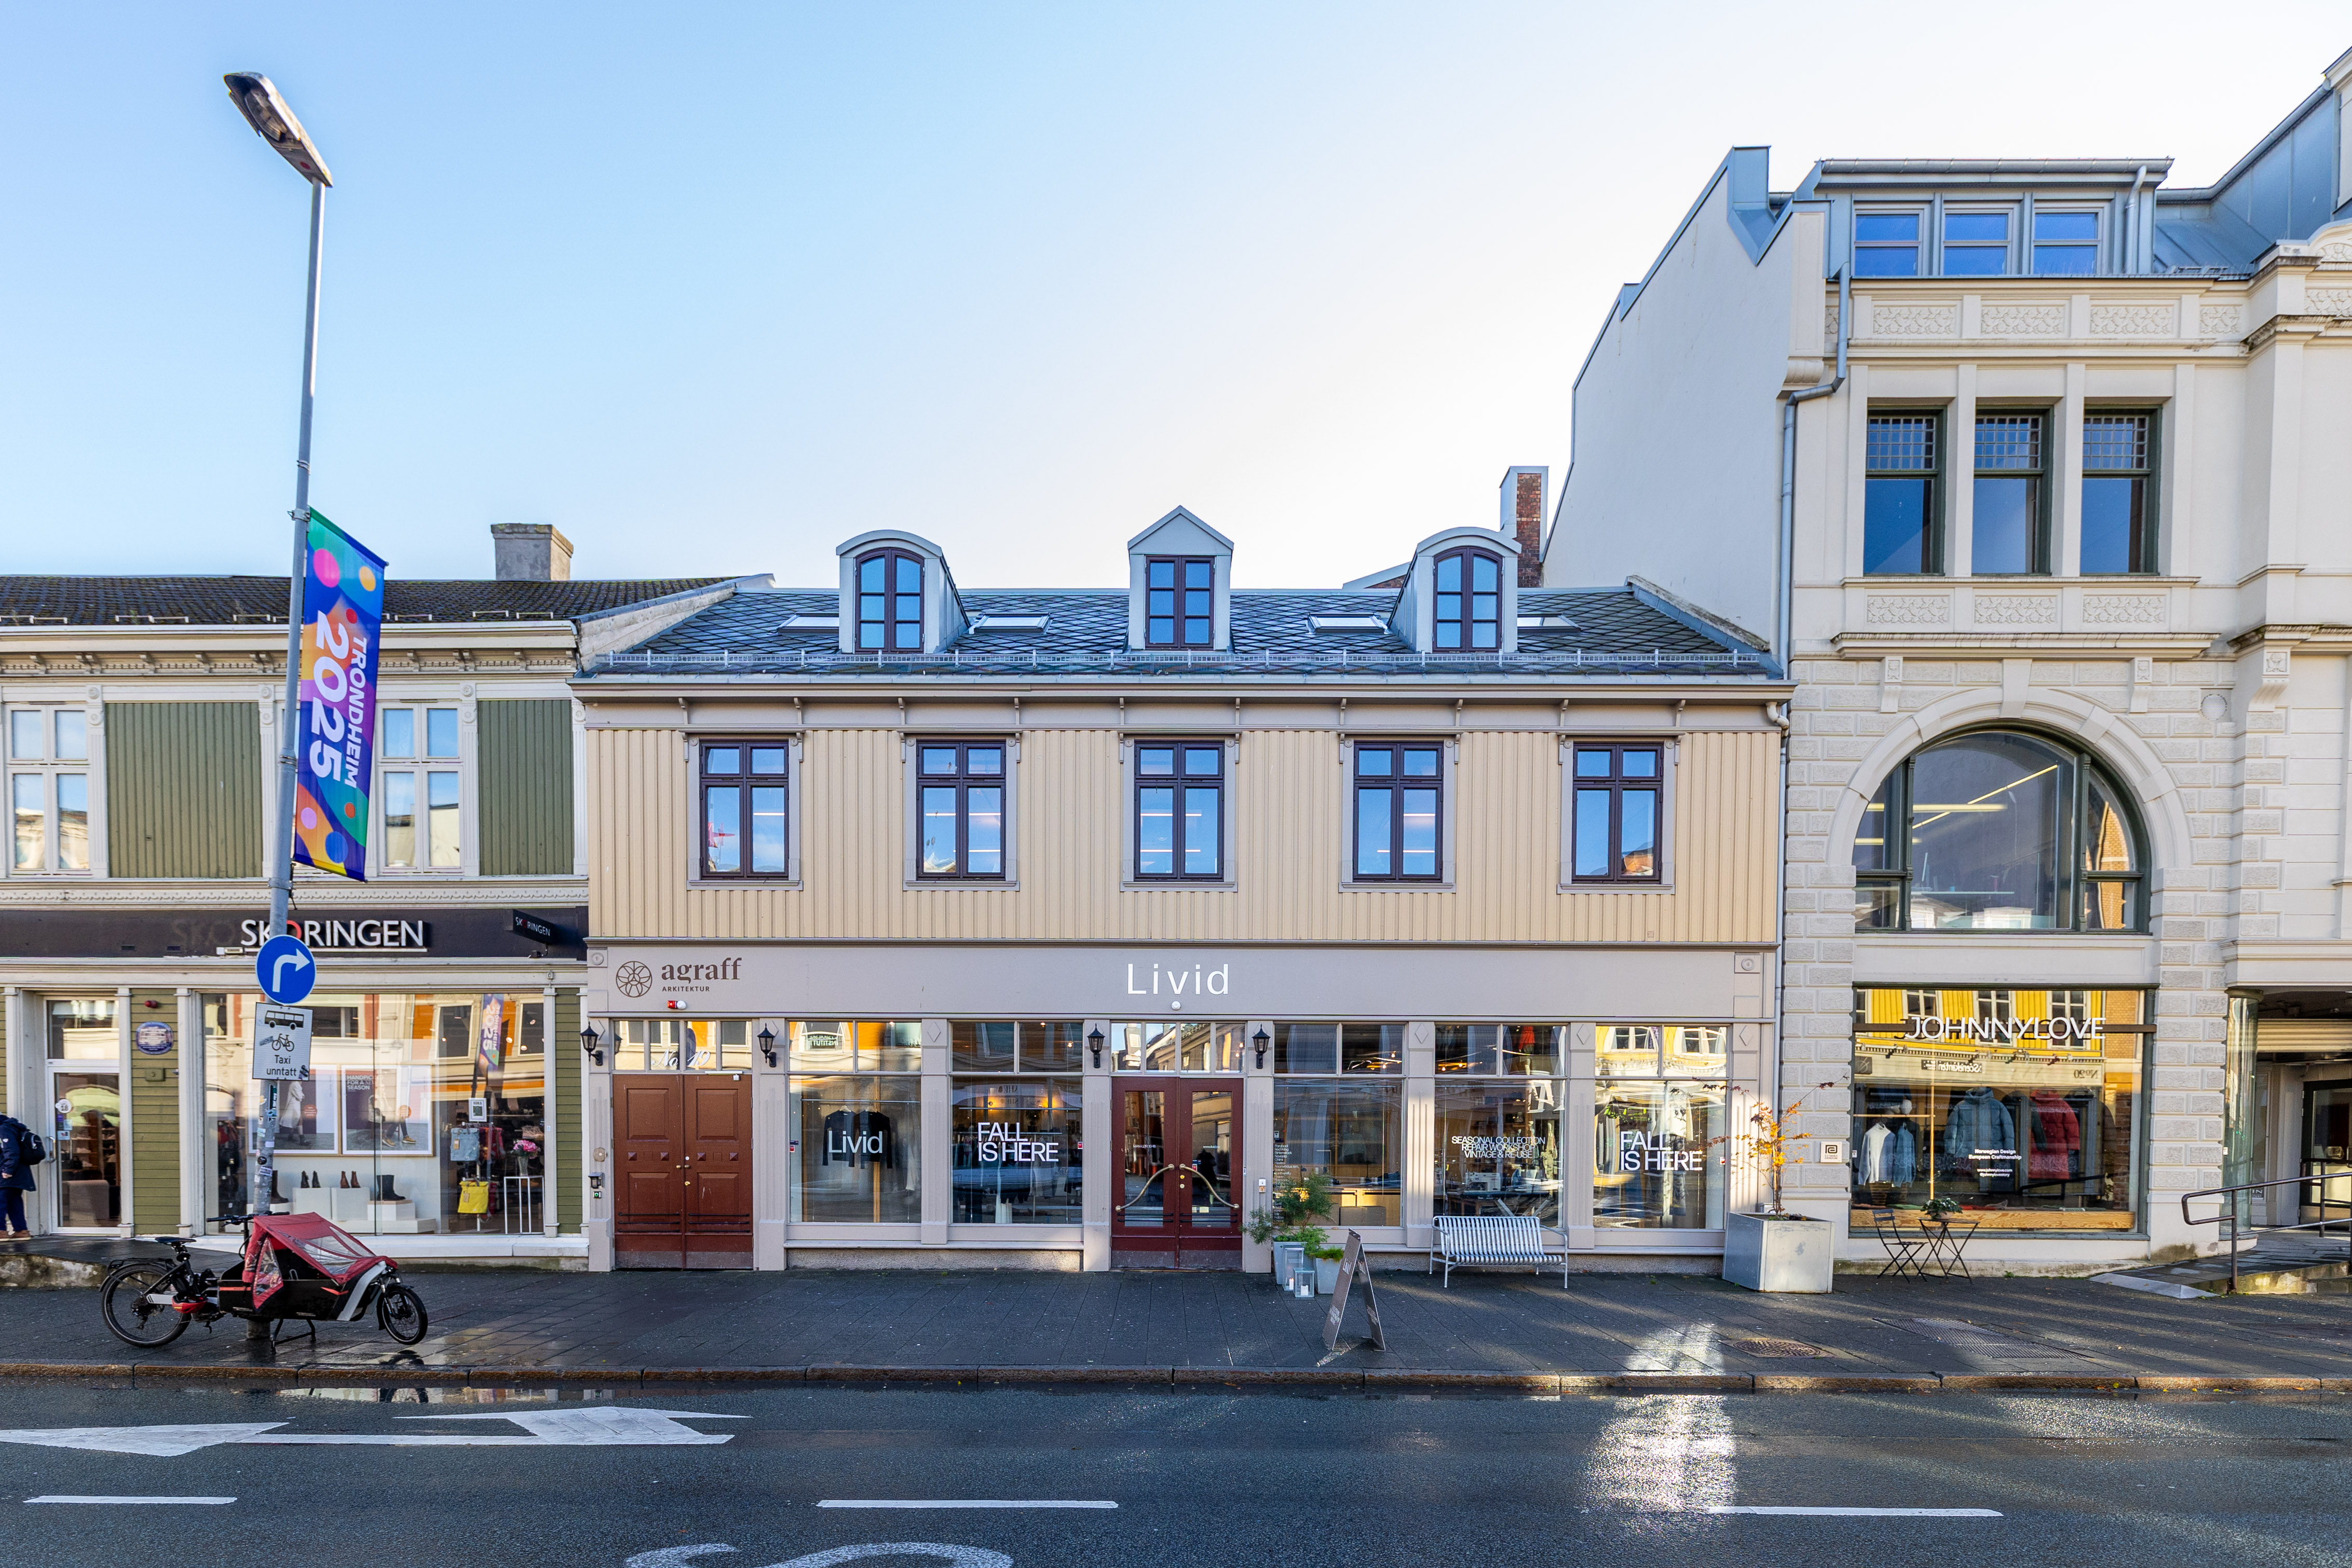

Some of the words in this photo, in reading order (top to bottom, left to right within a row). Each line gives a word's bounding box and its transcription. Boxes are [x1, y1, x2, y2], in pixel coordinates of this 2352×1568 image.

[309, 610, 349, 782] 2025
[345, 636, 368, 788] TRONDHEIM
[661, 957, 742, 984] agraff
[1127, 963, 1229, 995] Livid
[1905, 1016, 2106, 1039] JOHNNYLOVE
[275, 1055, 291, 1064] Taxi
[266, 1068, 296, 1076] unntatt
[828, 1130, 883, 1153] Livid
[978, 1122, 1028, 1142] FALL
[1451, 1136, 1495, 1144] SEASONAL
[1620, 1131, 1671, 1151] FALL
[978, 1142, 998, 1162] IS
[1002, 1142, 1058, 1162] HERE
[1620, 1151, 1640, 1171] IS
[1644, 1151, 1703, 1171] HERE
